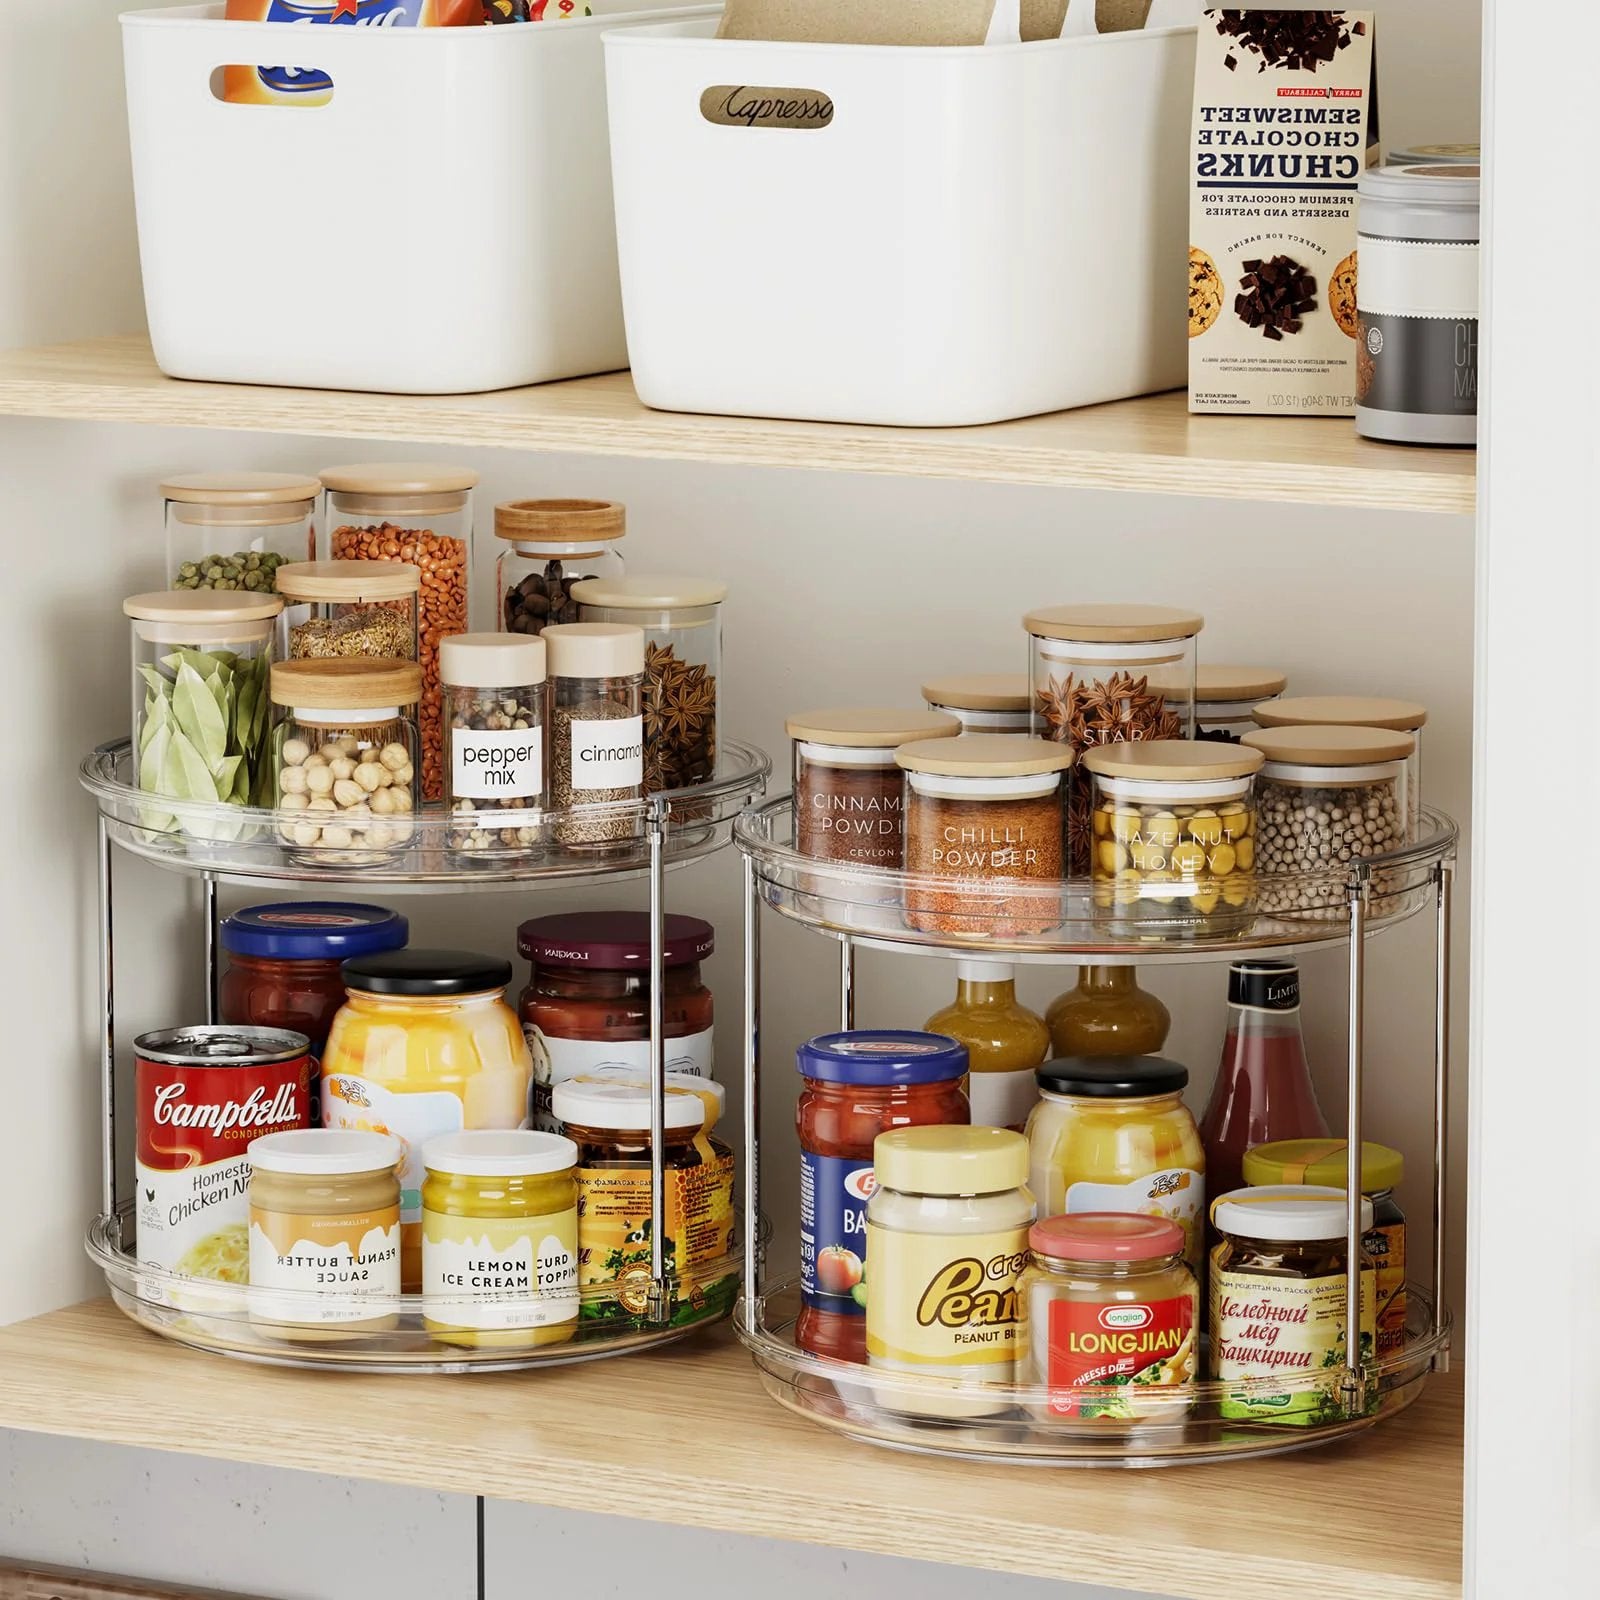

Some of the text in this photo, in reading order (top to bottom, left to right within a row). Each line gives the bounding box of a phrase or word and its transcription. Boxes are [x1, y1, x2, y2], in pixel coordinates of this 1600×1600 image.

[463, 745, 534, 768] pepper
[484, 768, 516, 785] mix
[813, 793, 903, 812] CINNAM
[944, 826, 1024, 843] CHILLI
[1117, 828, 1234, 847] HAZELNUT
[1303, 829, 1355, 840] WHITE
[849, 849, 894, 857] CEYLON
[932, 848, 1037, 867] POWDER
[1133, 854, 1217, 870] HONEY
[169, 1187, 229, 1226] Chicken
[468, 1261, 526, 1272] LEMON
[536, 1254, 569, 1269] CURD
[442, 1273, 464, 1286] ICE
[471, 1276, 529, 1288] CREAM
[1109, 1313, 1143, 1323] longjian
[954, 1331, 1000, 1343] PEANUT
[1069, 1327, 1181, 1354] LONGJIAN
[1239, 1322, 1281, 1347] мёд
[1073, 1363, 1127, 1386] CHEESE DIP
